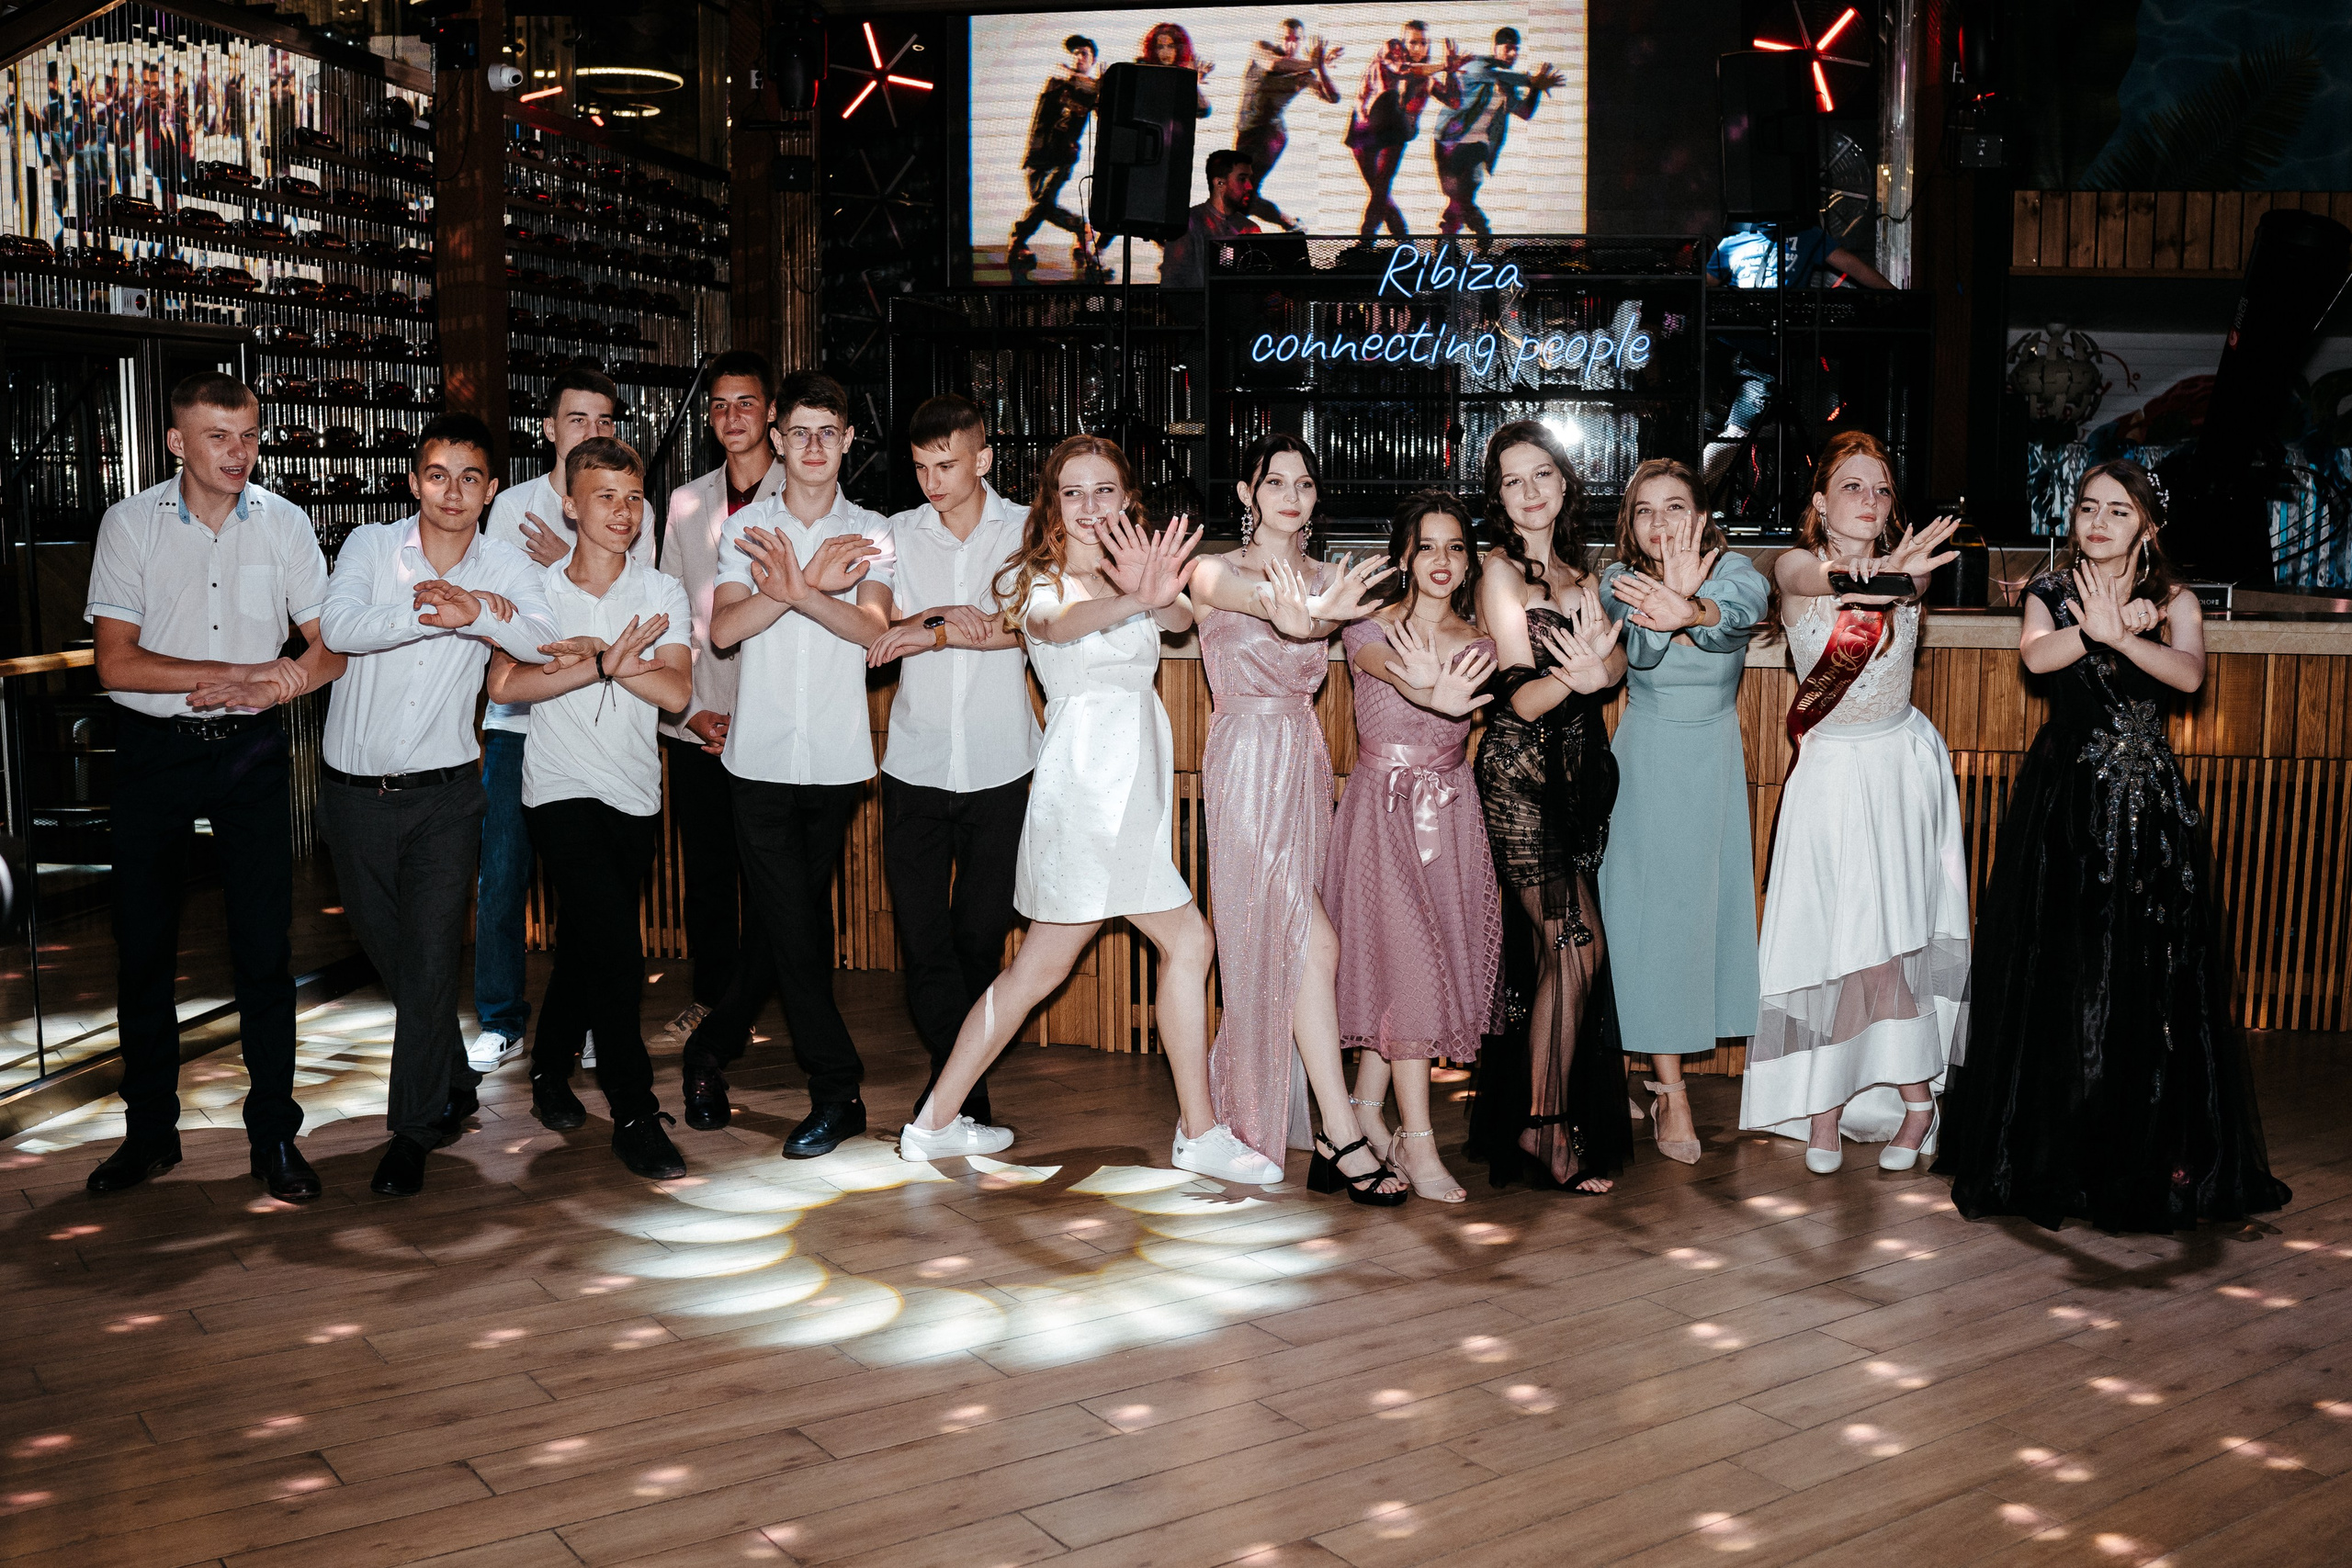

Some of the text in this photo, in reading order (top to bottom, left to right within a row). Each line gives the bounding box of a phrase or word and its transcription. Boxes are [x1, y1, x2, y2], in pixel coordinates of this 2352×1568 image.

[1378, 243, 1524, 299] Ribiza
[1251, 313, 1651, 381] connecting people
